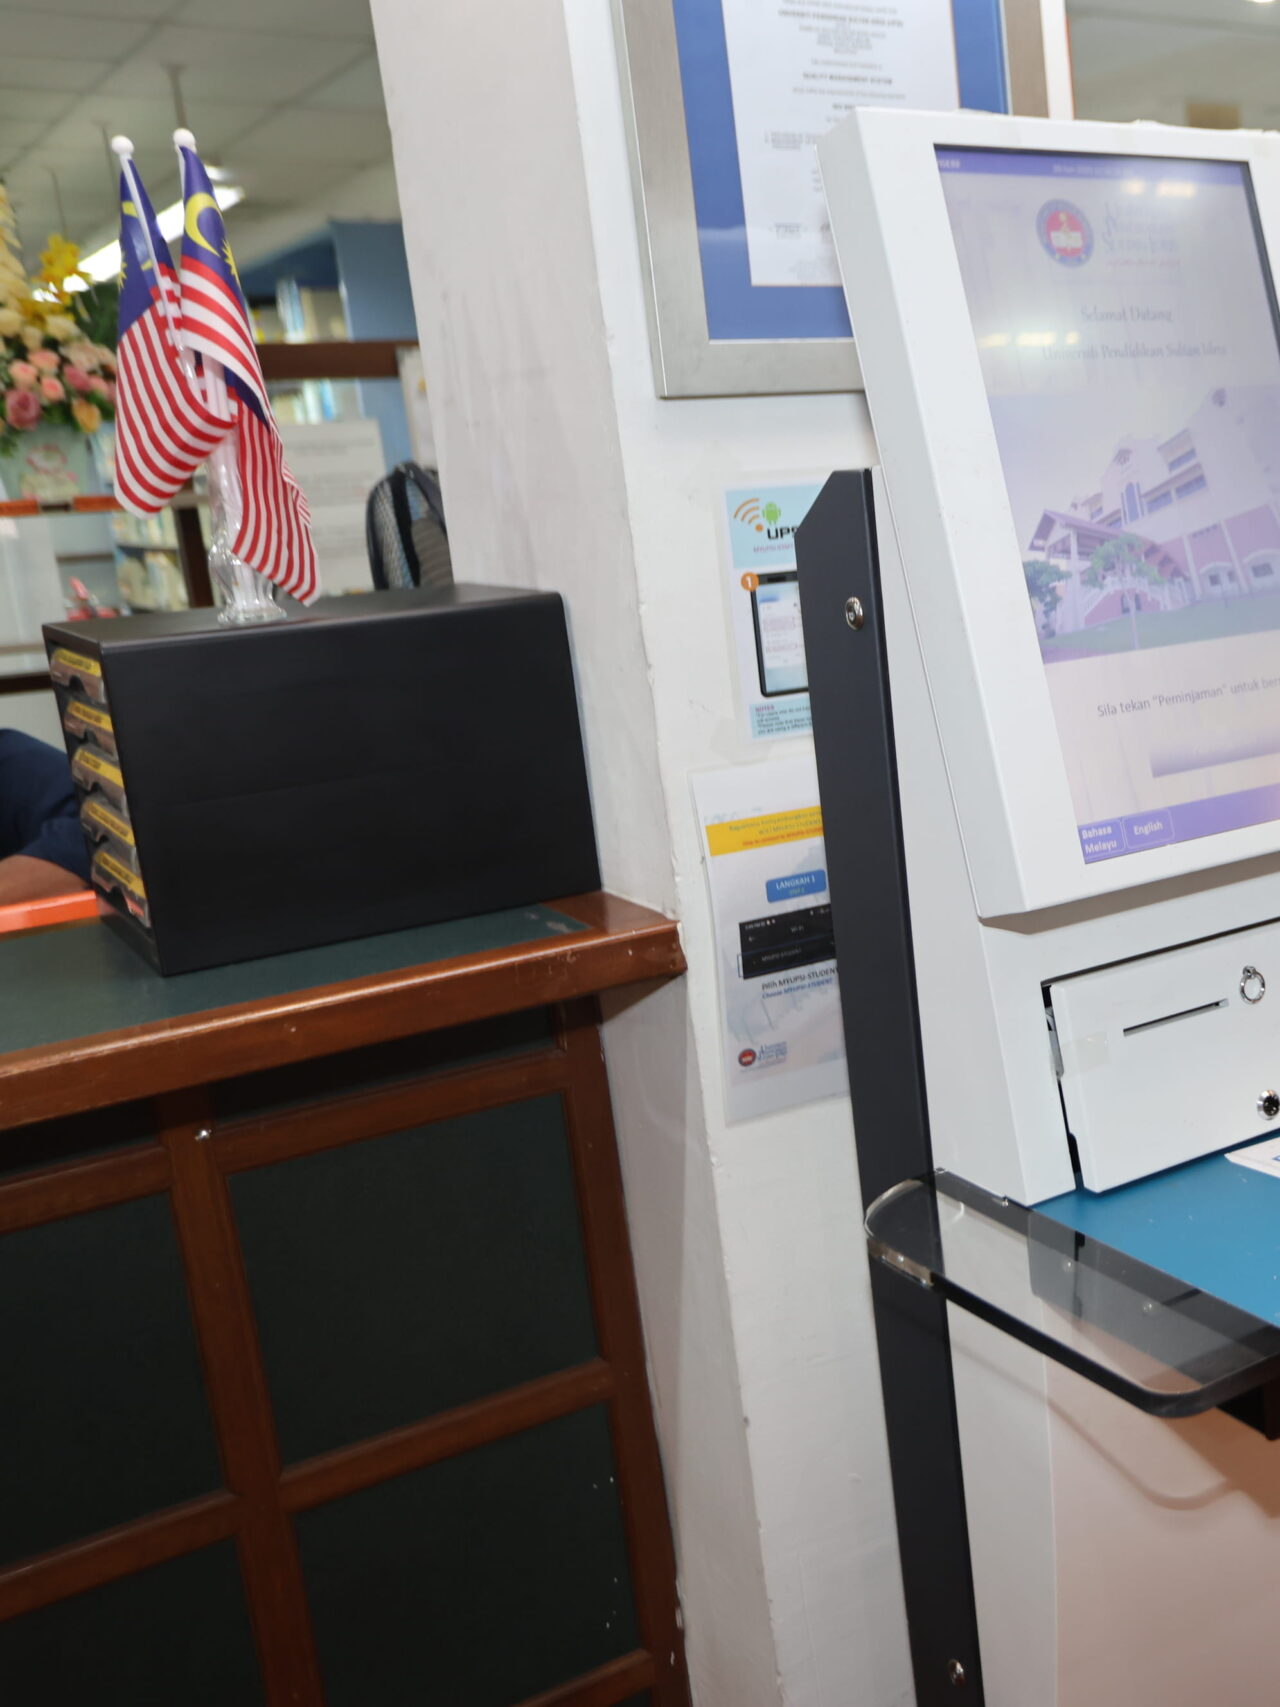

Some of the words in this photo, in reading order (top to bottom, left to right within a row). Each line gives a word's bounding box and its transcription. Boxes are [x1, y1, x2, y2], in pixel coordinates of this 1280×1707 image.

[1081, 304, 1127, 322] Selamat
[1096, 703, 1117, 718] Sila
[1120, 698, 1151, 715] tekan
[1153, 684, 1228, 707] "Peminjaman"
[1230, 680, 1260, 695] untuk
[1081, 825, 1113, 840] Bahasa
[1133, 820, 1164, 836] English
[1084, 840, 1118, 854] Melayu
[775, 876, 808, 890] LANGKAH
